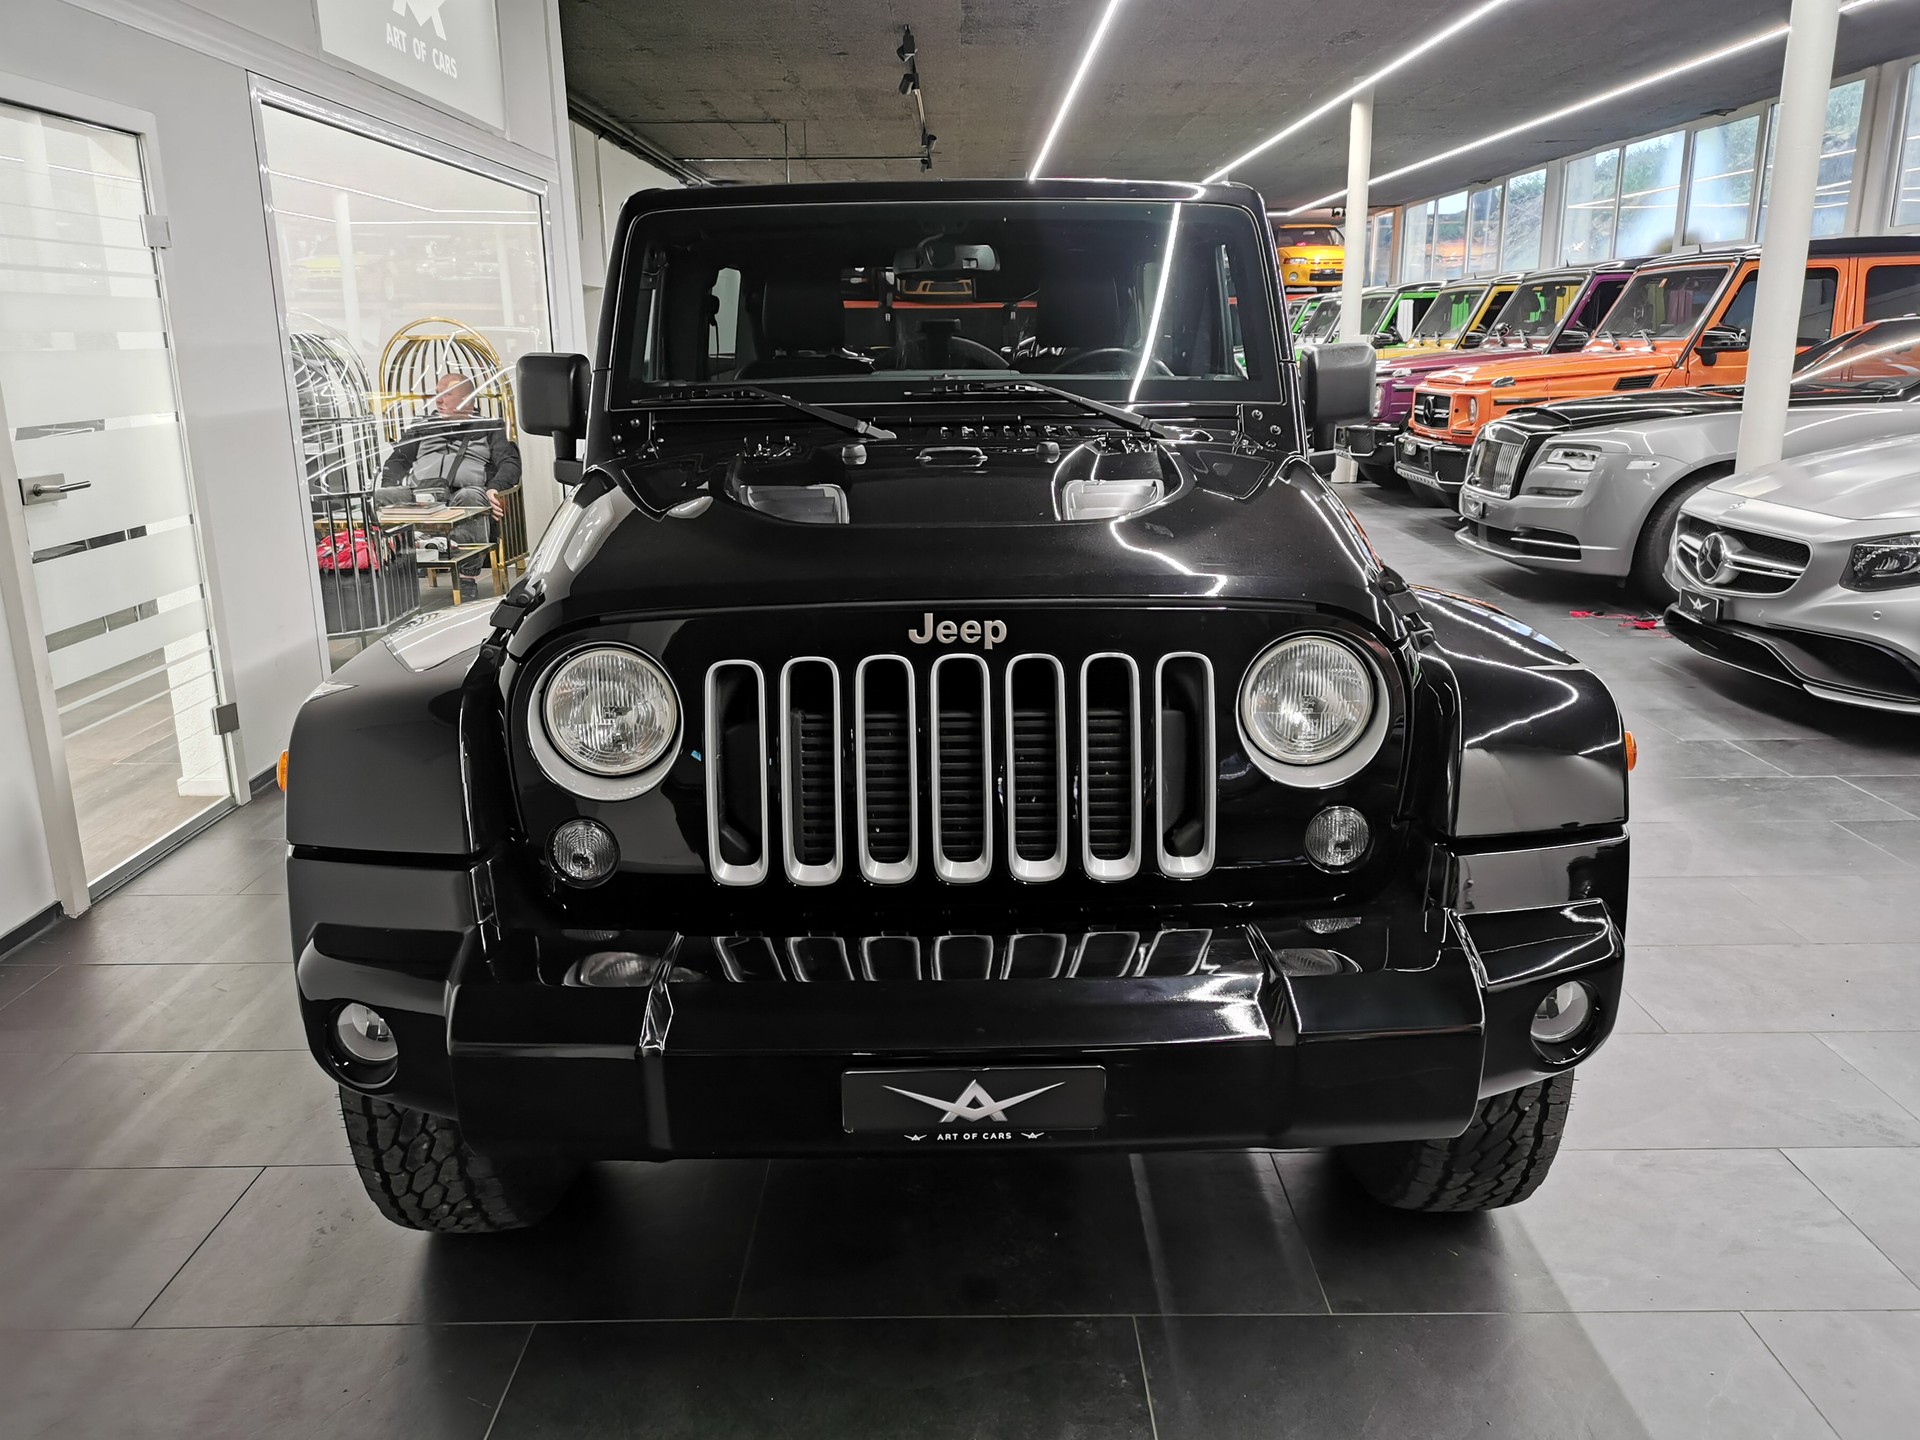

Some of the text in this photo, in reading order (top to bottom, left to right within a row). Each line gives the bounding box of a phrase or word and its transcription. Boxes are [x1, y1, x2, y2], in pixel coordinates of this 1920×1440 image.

[386, 22, 458, 79] ART OF CARS
[908, 612, 1008, 650] Jeep
[936, 1132, 1012, 1141] ART OF CARS
